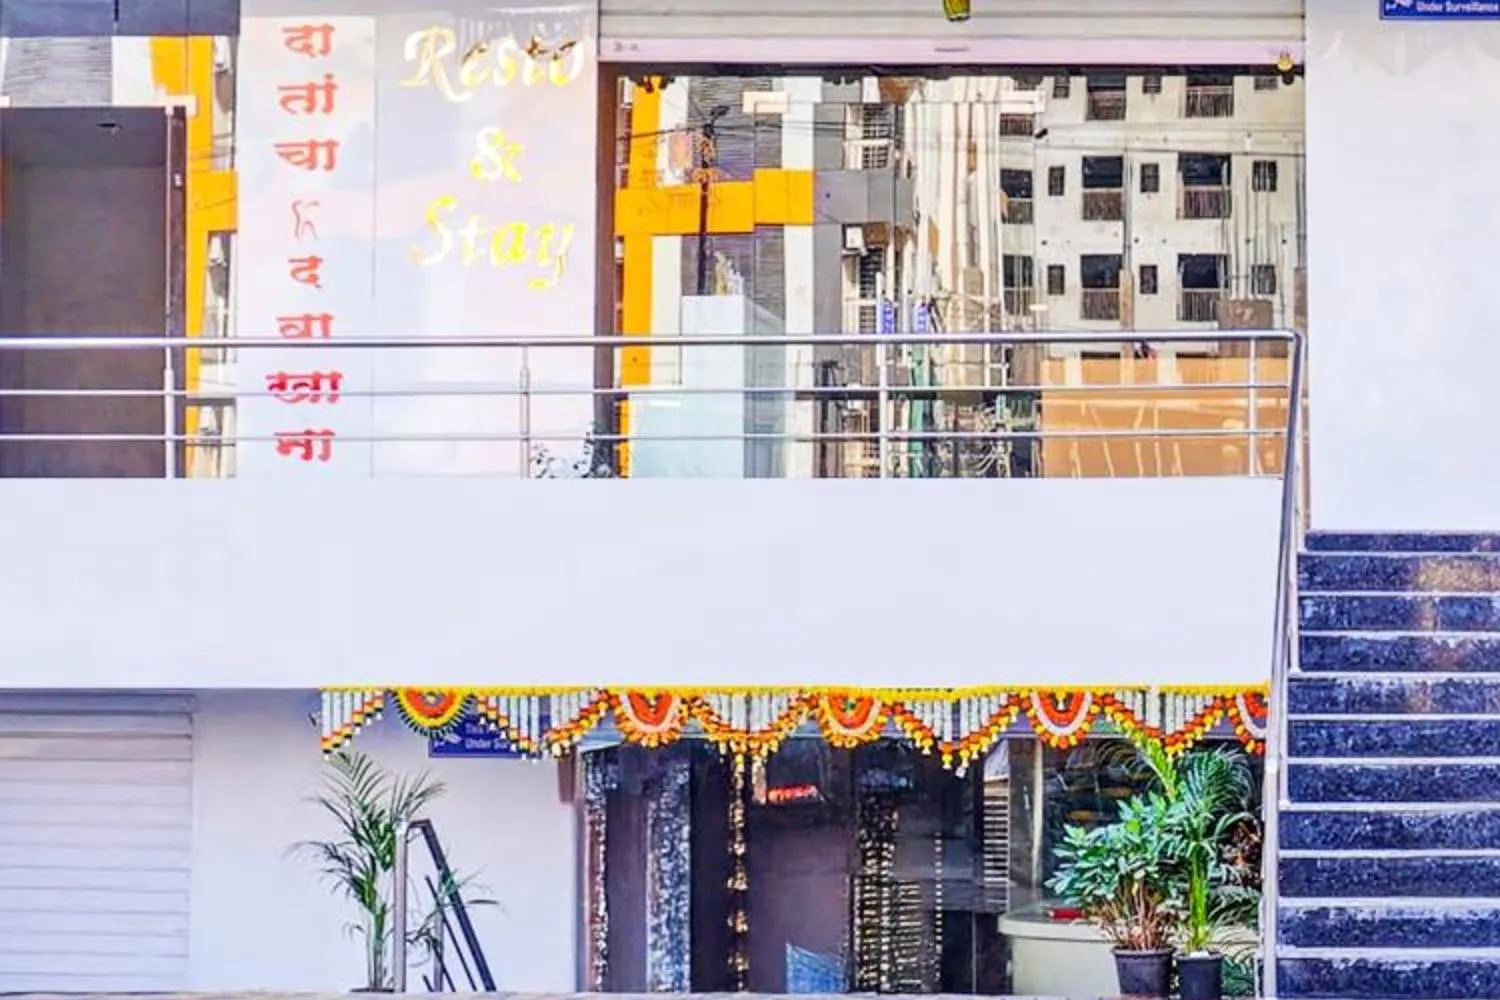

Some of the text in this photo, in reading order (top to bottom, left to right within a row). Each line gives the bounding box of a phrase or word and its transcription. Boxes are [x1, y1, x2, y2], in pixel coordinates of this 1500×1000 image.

[1416, 1, 1499, 12] Under Surveillance
[400, 26, 584, 103] Resto
[470, 127, 524, 181] &
[410, 196, 575, 288] Stay
